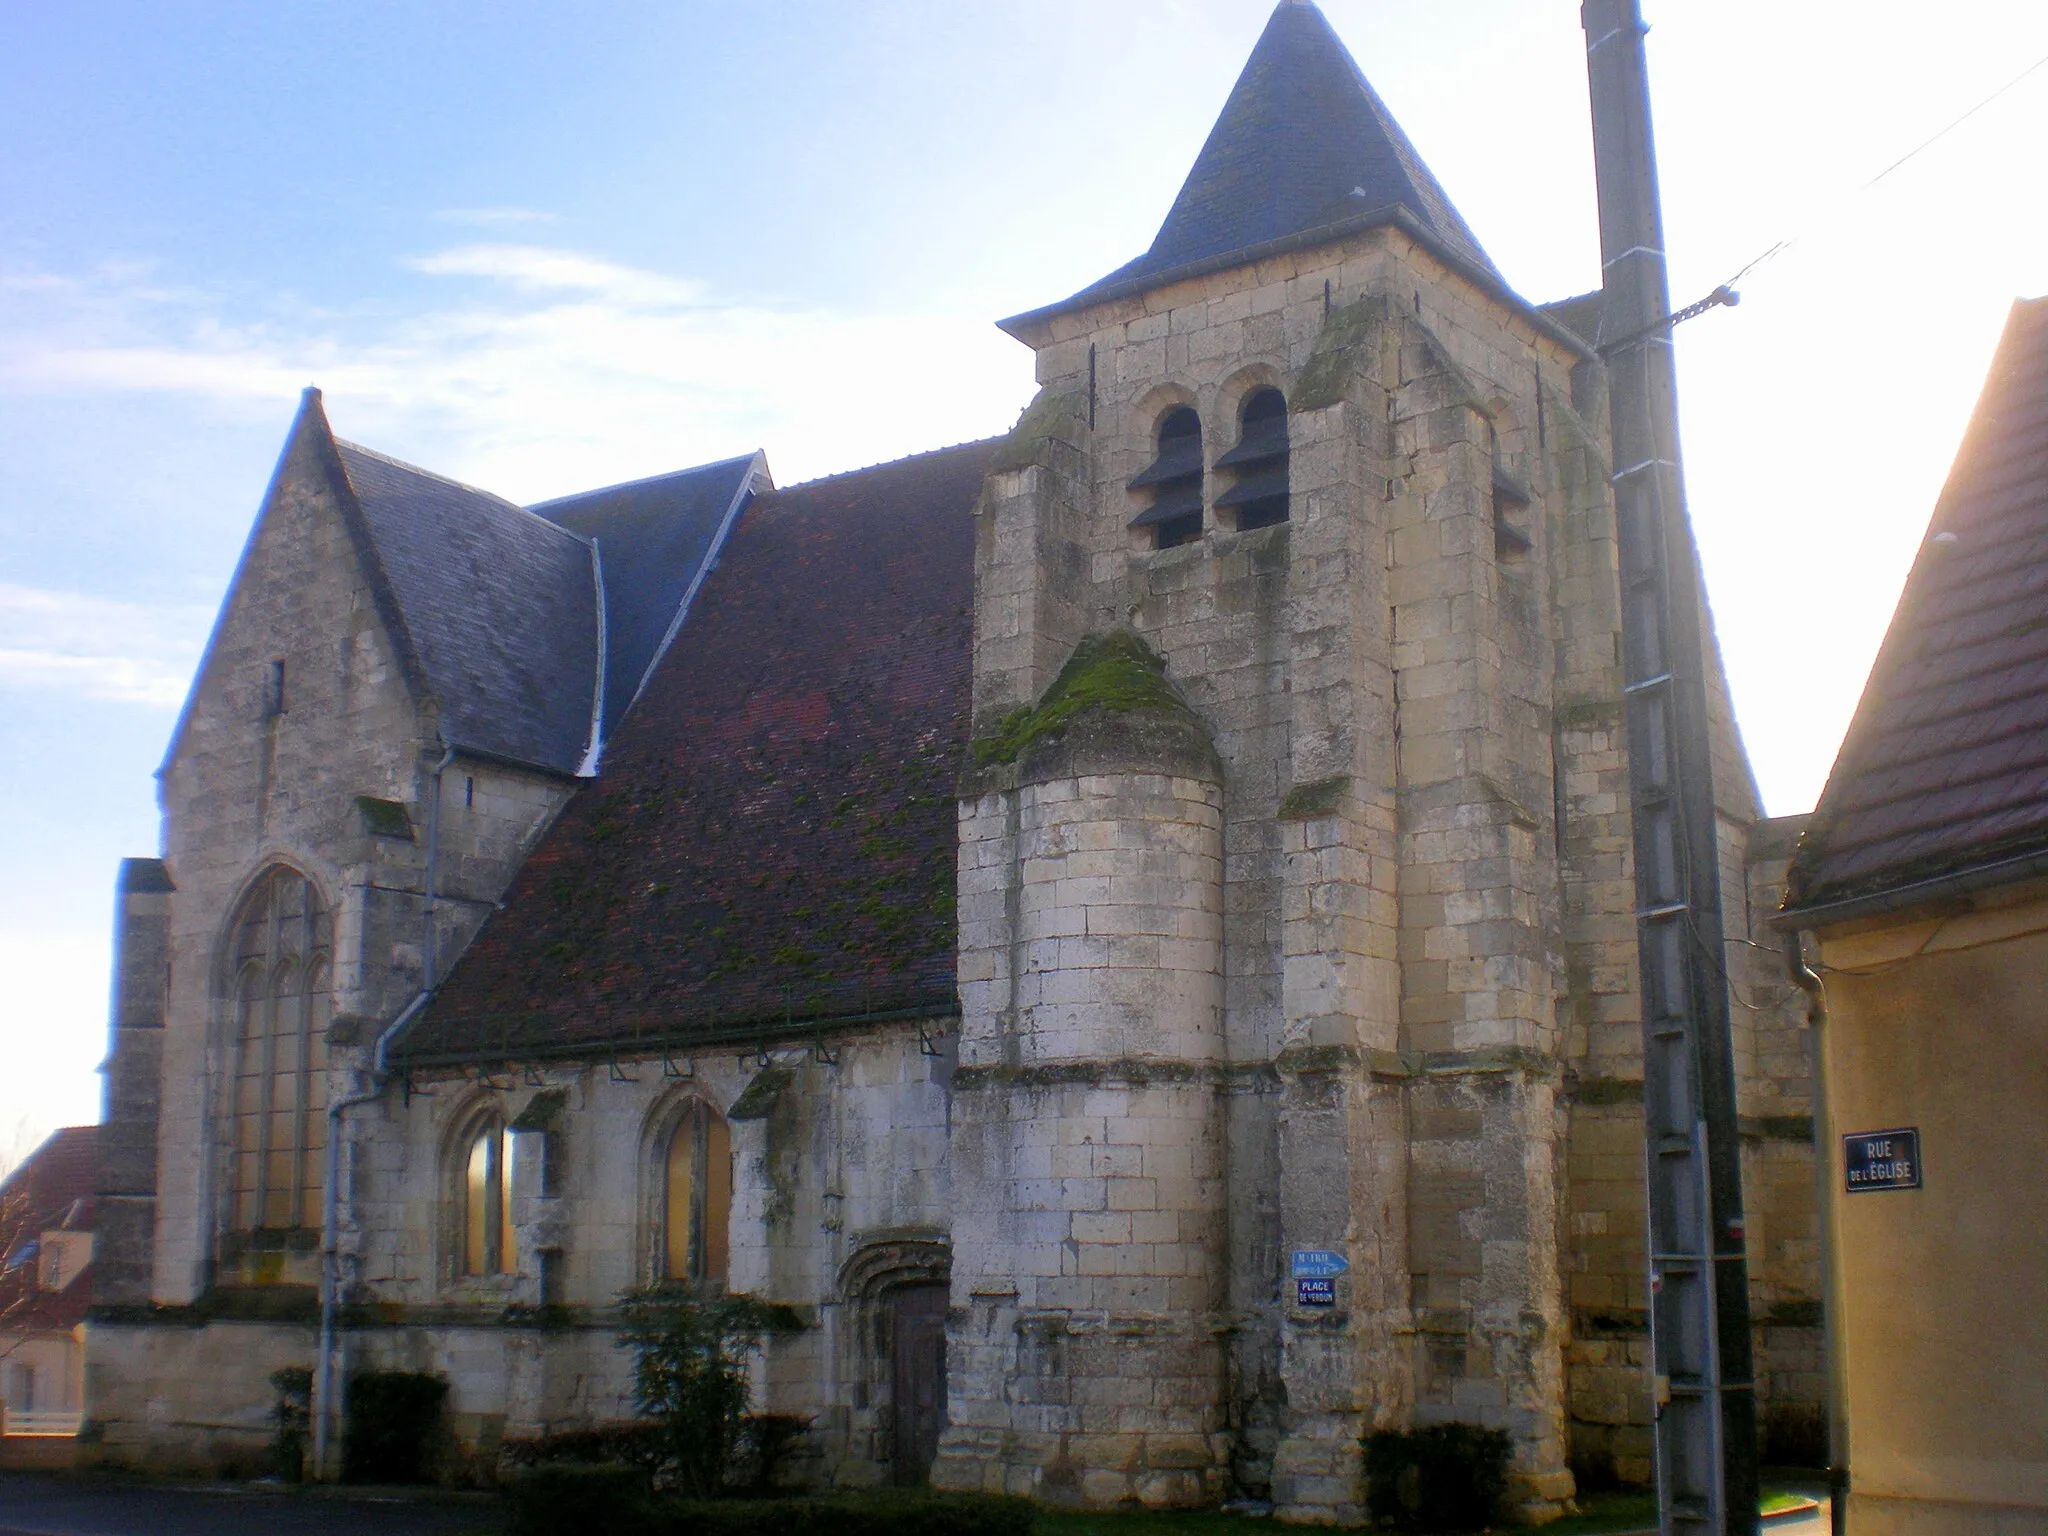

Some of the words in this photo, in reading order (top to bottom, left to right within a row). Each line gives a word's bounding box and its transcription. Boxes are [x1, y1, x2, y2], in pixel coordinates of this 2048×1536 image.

[1867, 1140, 1892, 1158] RUE
[1850, 1169, 1861, 1181] DE
[1302, 1281, 1329, 1291] PLACE
[1299, 1293, 1307, 1302] DE
